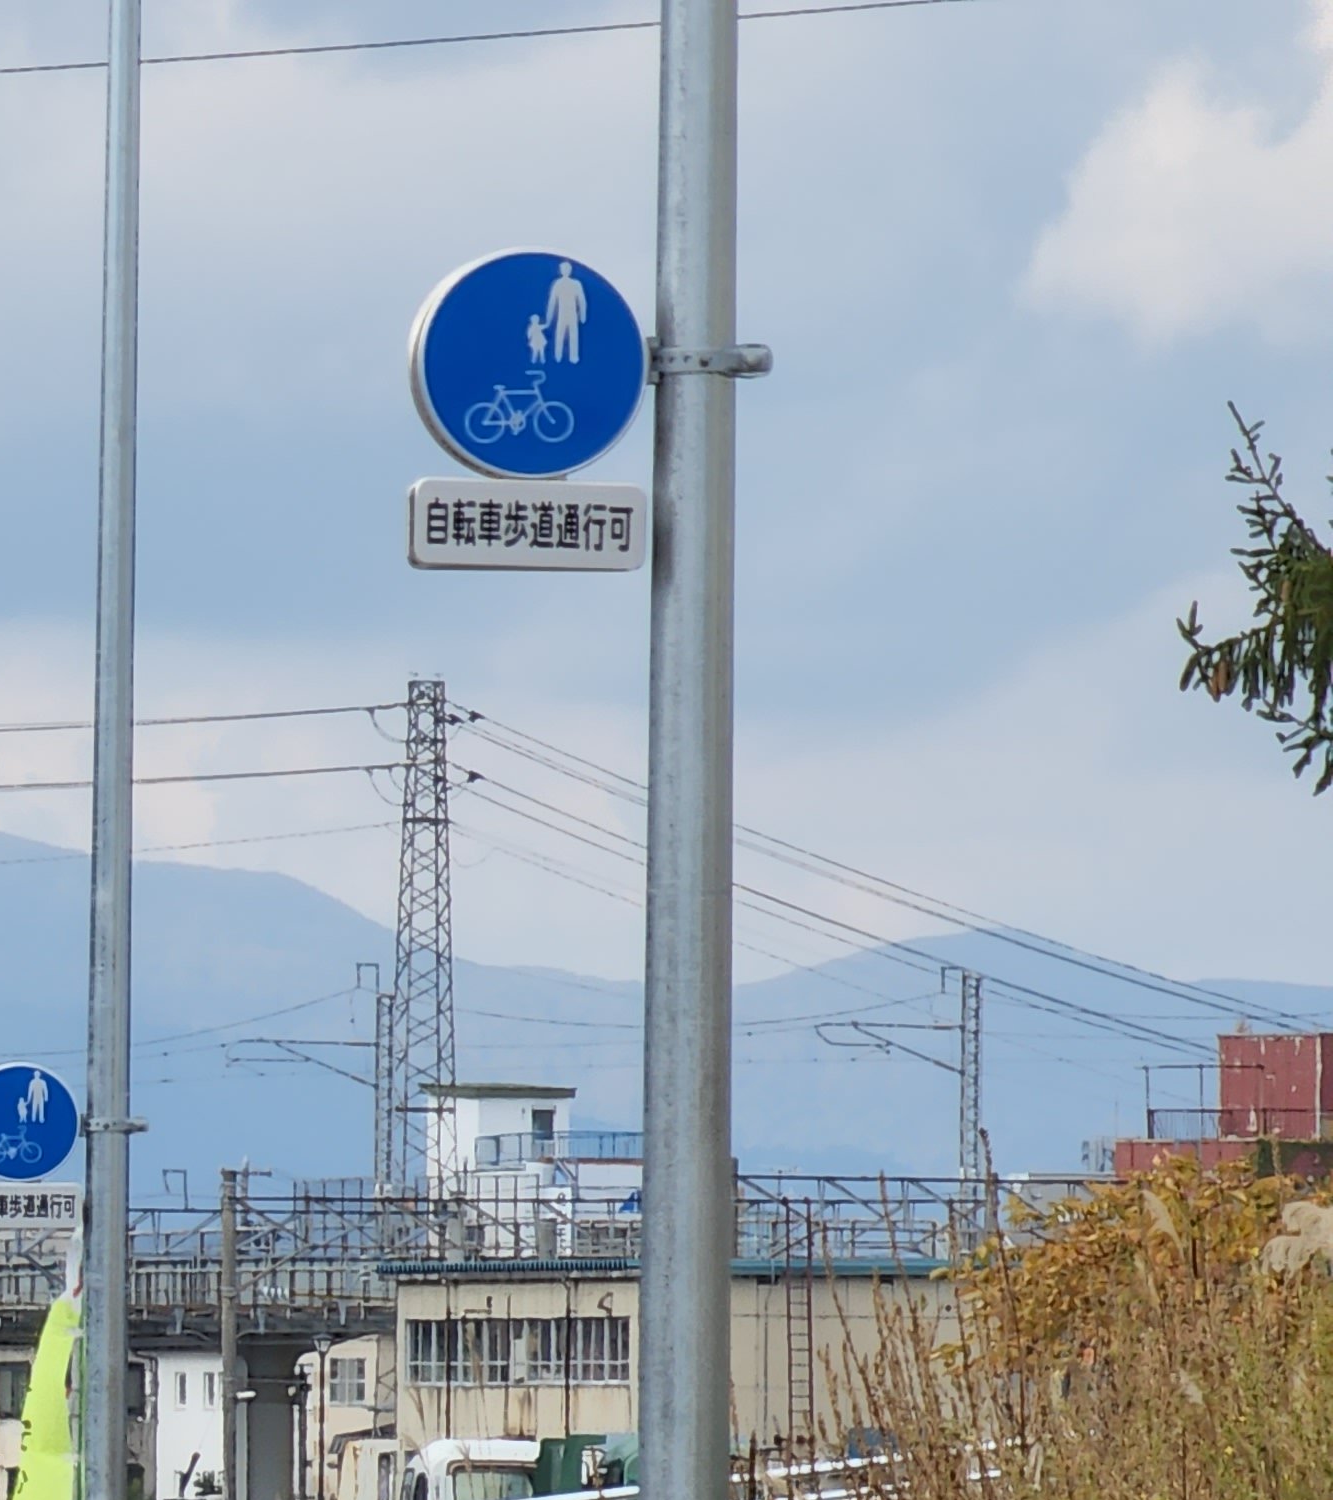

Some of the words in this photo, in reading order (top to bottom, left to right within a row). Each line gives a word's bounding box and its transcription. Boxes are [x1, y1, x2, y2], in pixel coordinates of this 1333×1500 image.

[426, 498, 634, 552] 自転車歩道通行可
